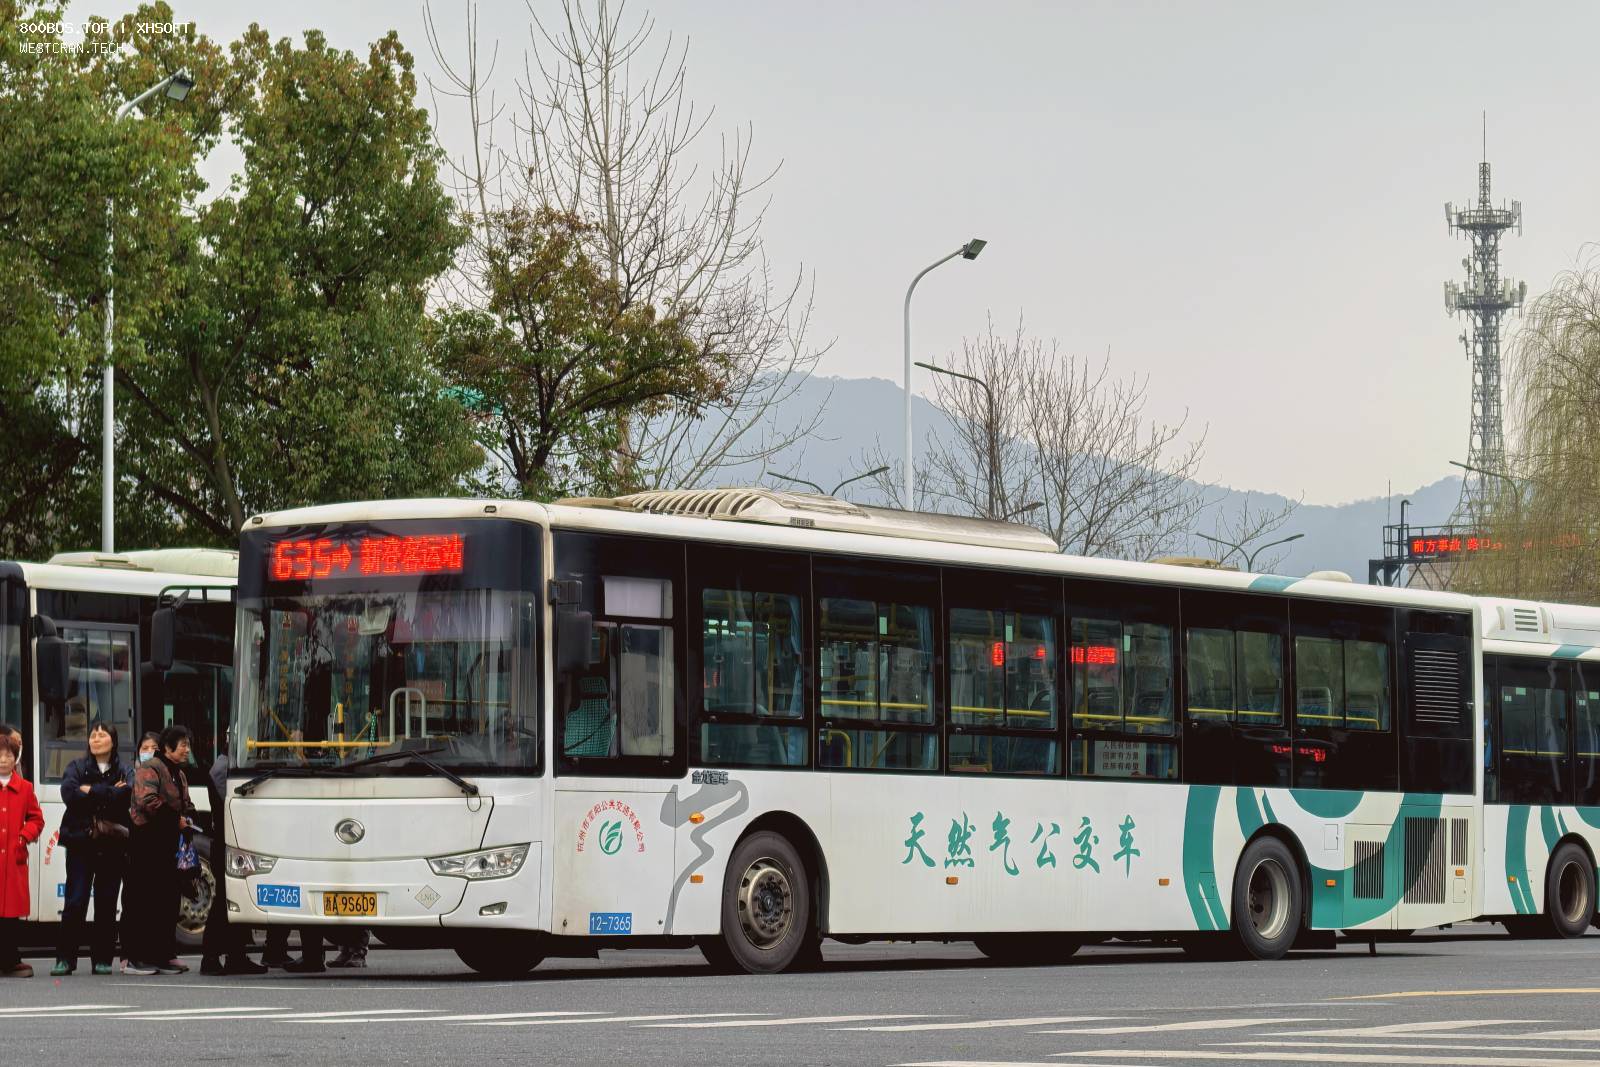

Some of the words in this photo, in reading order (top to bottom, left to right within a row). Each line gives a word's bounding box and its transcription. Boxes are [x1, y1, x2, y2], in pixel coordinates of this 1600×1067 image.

[1413, 538, 1461, 553] 前方事故
[273, 538, 332, 580] 635
[902, 811, 1141, 878] 天然气公交车
[257, 887, 299, 904] 12-7365
[591, 916, 631, 931] 12-7365
